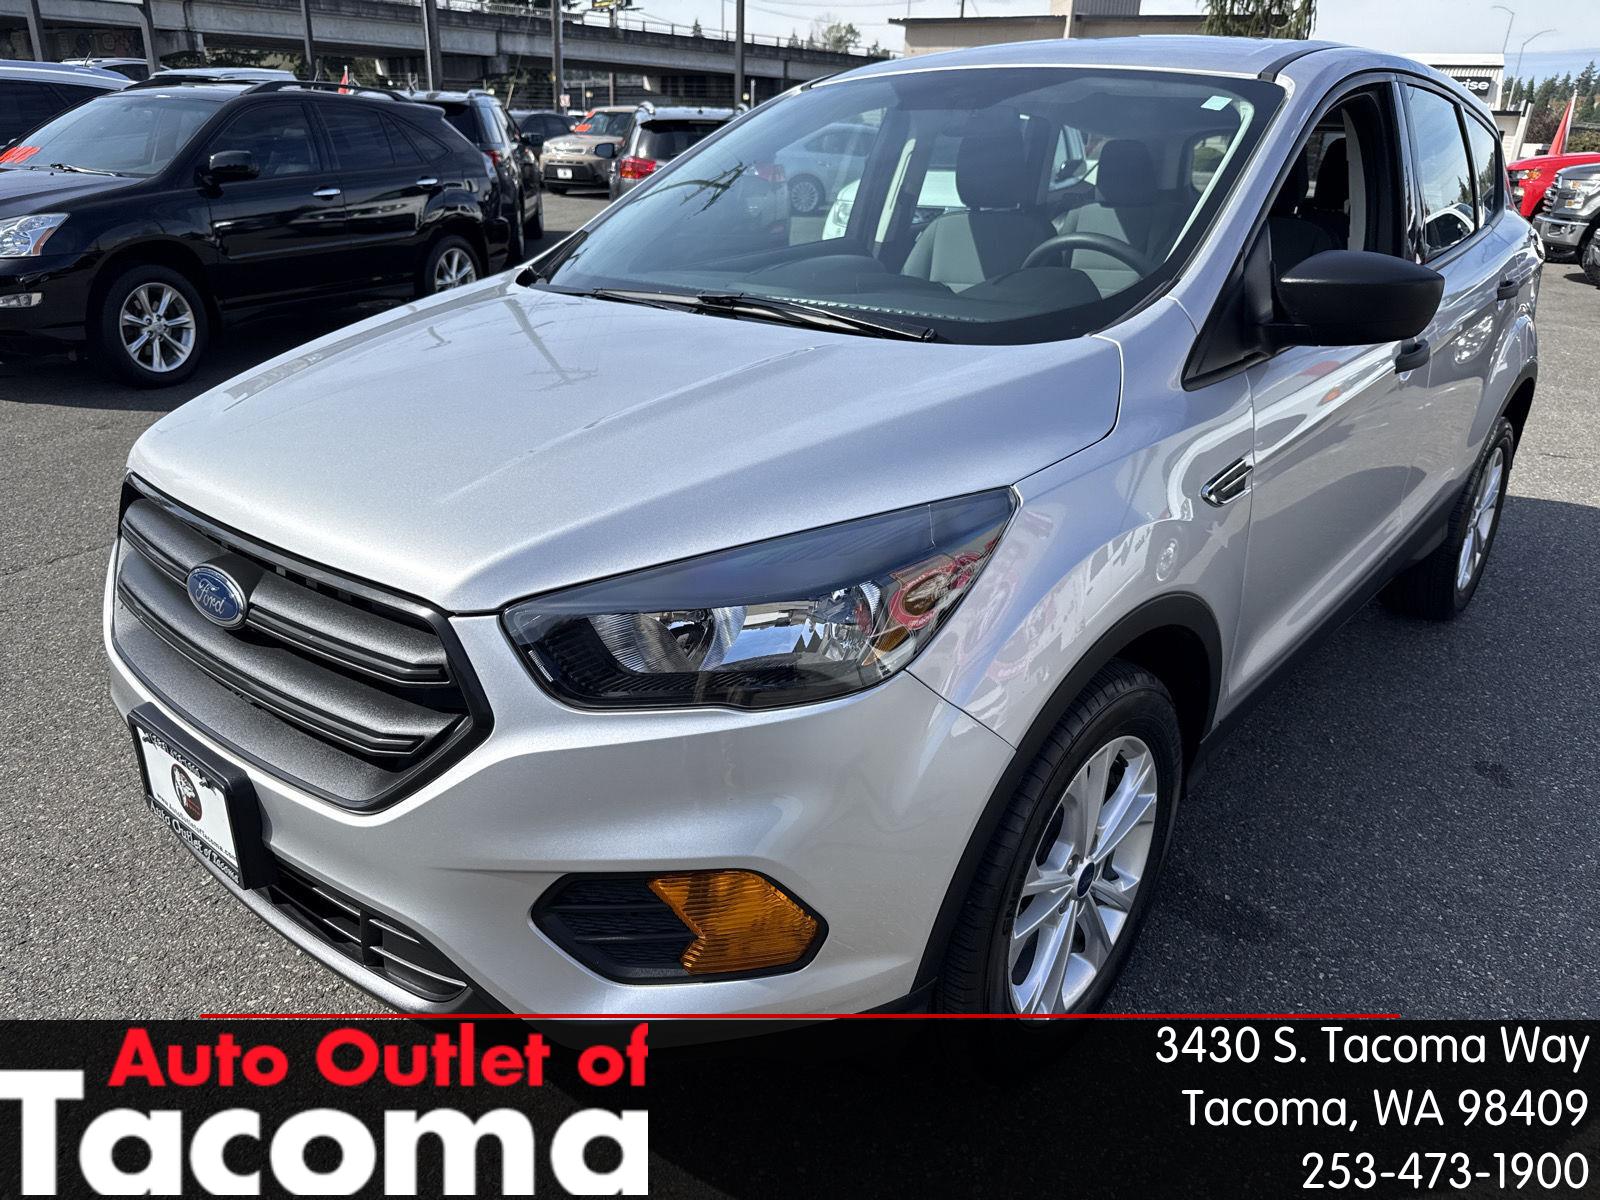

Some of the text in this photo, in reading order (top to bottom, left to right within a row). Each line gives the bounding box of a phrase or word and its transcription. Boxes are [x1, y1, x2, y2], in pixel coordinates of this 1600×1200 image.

[195, 578, 227, 615] Ford
[150, 800, 171, 827] Auto
[172, 819, 203, 853] Outlet
[203, 847, 212, 859] of
[212, 851, 239, 884] Tacoma
